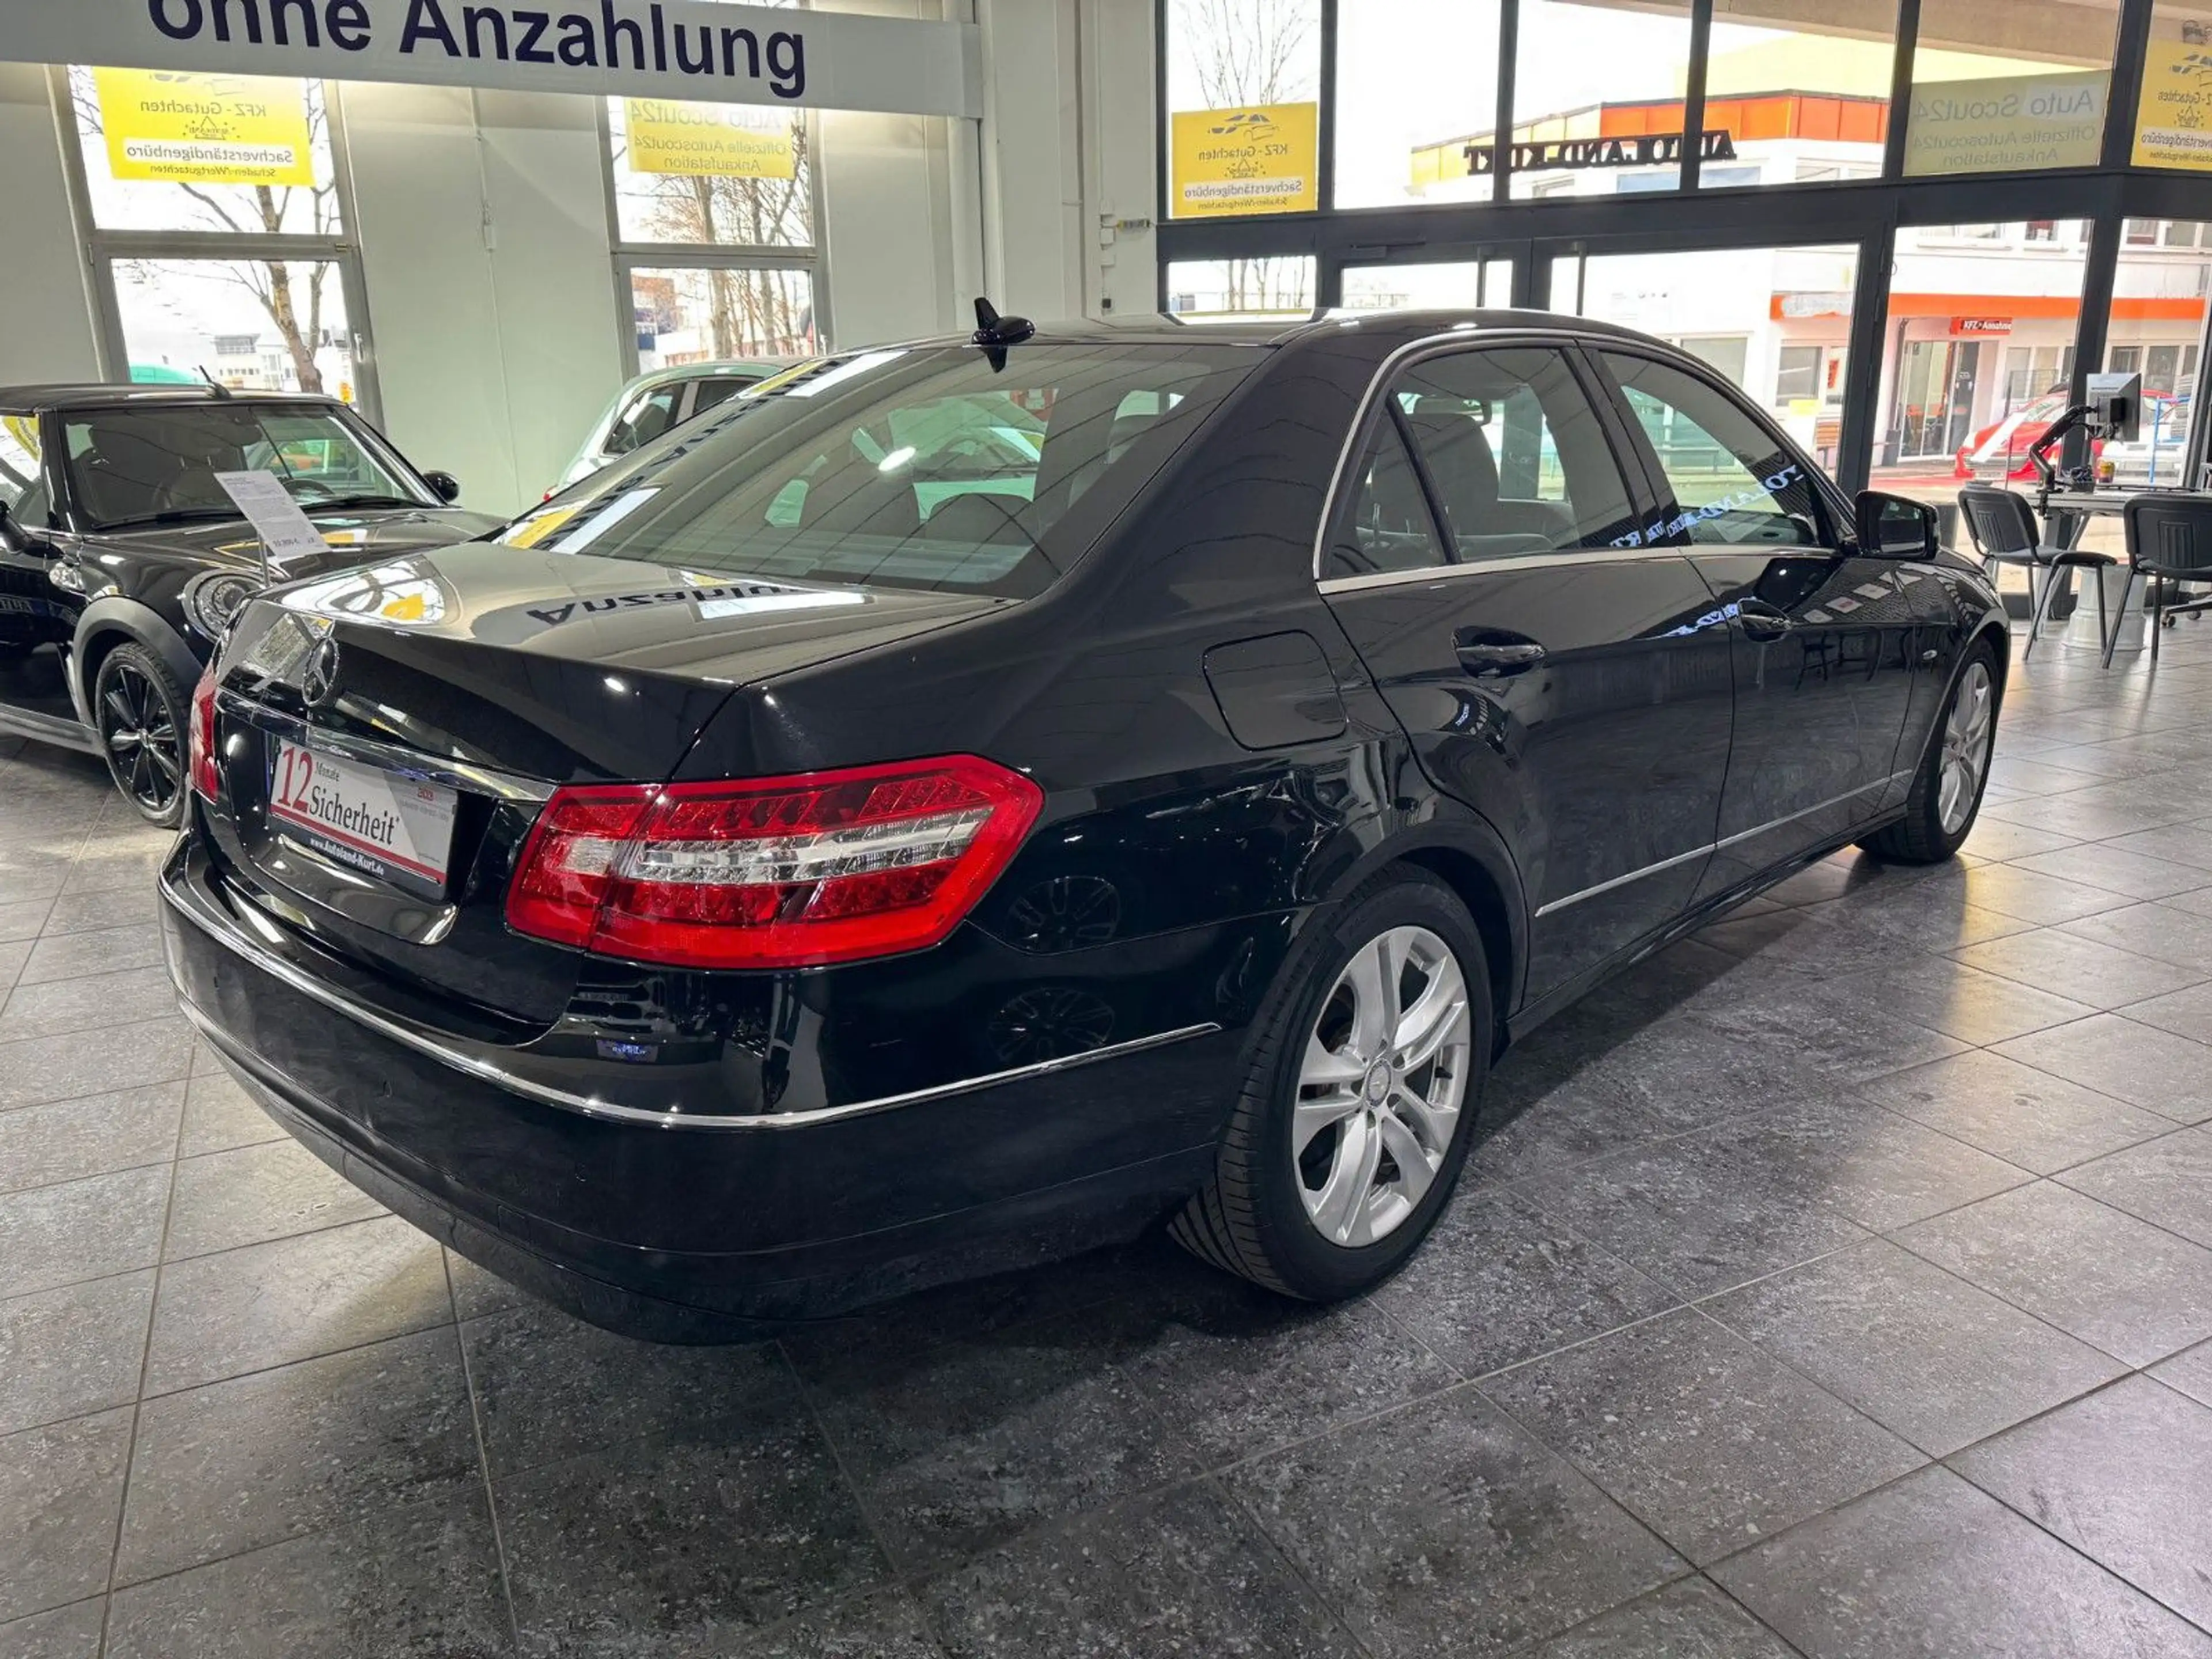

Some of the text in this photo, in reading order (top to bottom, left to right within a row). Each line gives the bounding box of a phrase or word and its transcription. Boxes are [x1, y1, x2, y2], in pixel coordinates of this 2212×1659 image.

[149, 0, 805, 99] ohne Anzahlung
[278, 747, 313, 815] 12
